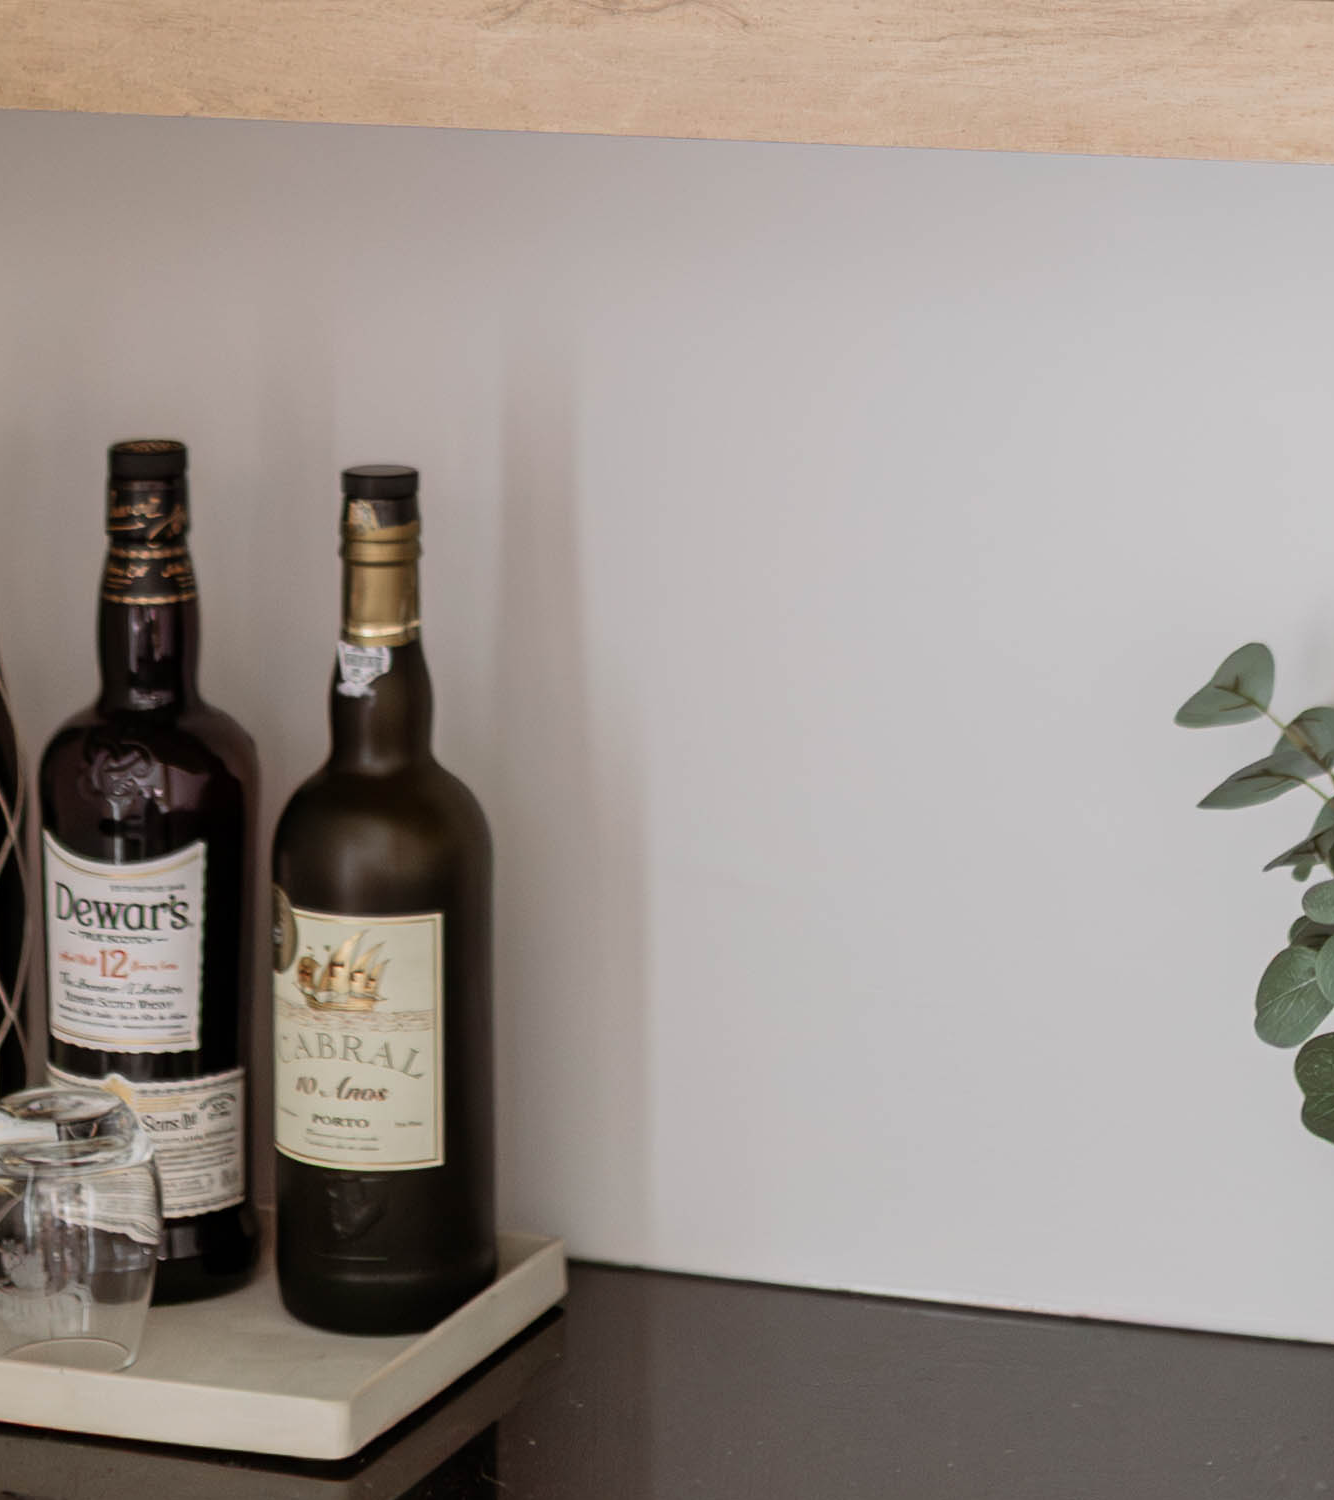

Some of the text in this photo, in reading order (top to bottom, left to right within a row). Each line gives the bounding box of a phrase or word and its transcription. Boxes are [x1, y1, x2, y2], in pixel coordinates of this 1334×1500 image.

[54, 881, 190, 931] Dewar's
[99, 949, 129, 979] 12
[311, 1112, 370, 1129] PORTO
